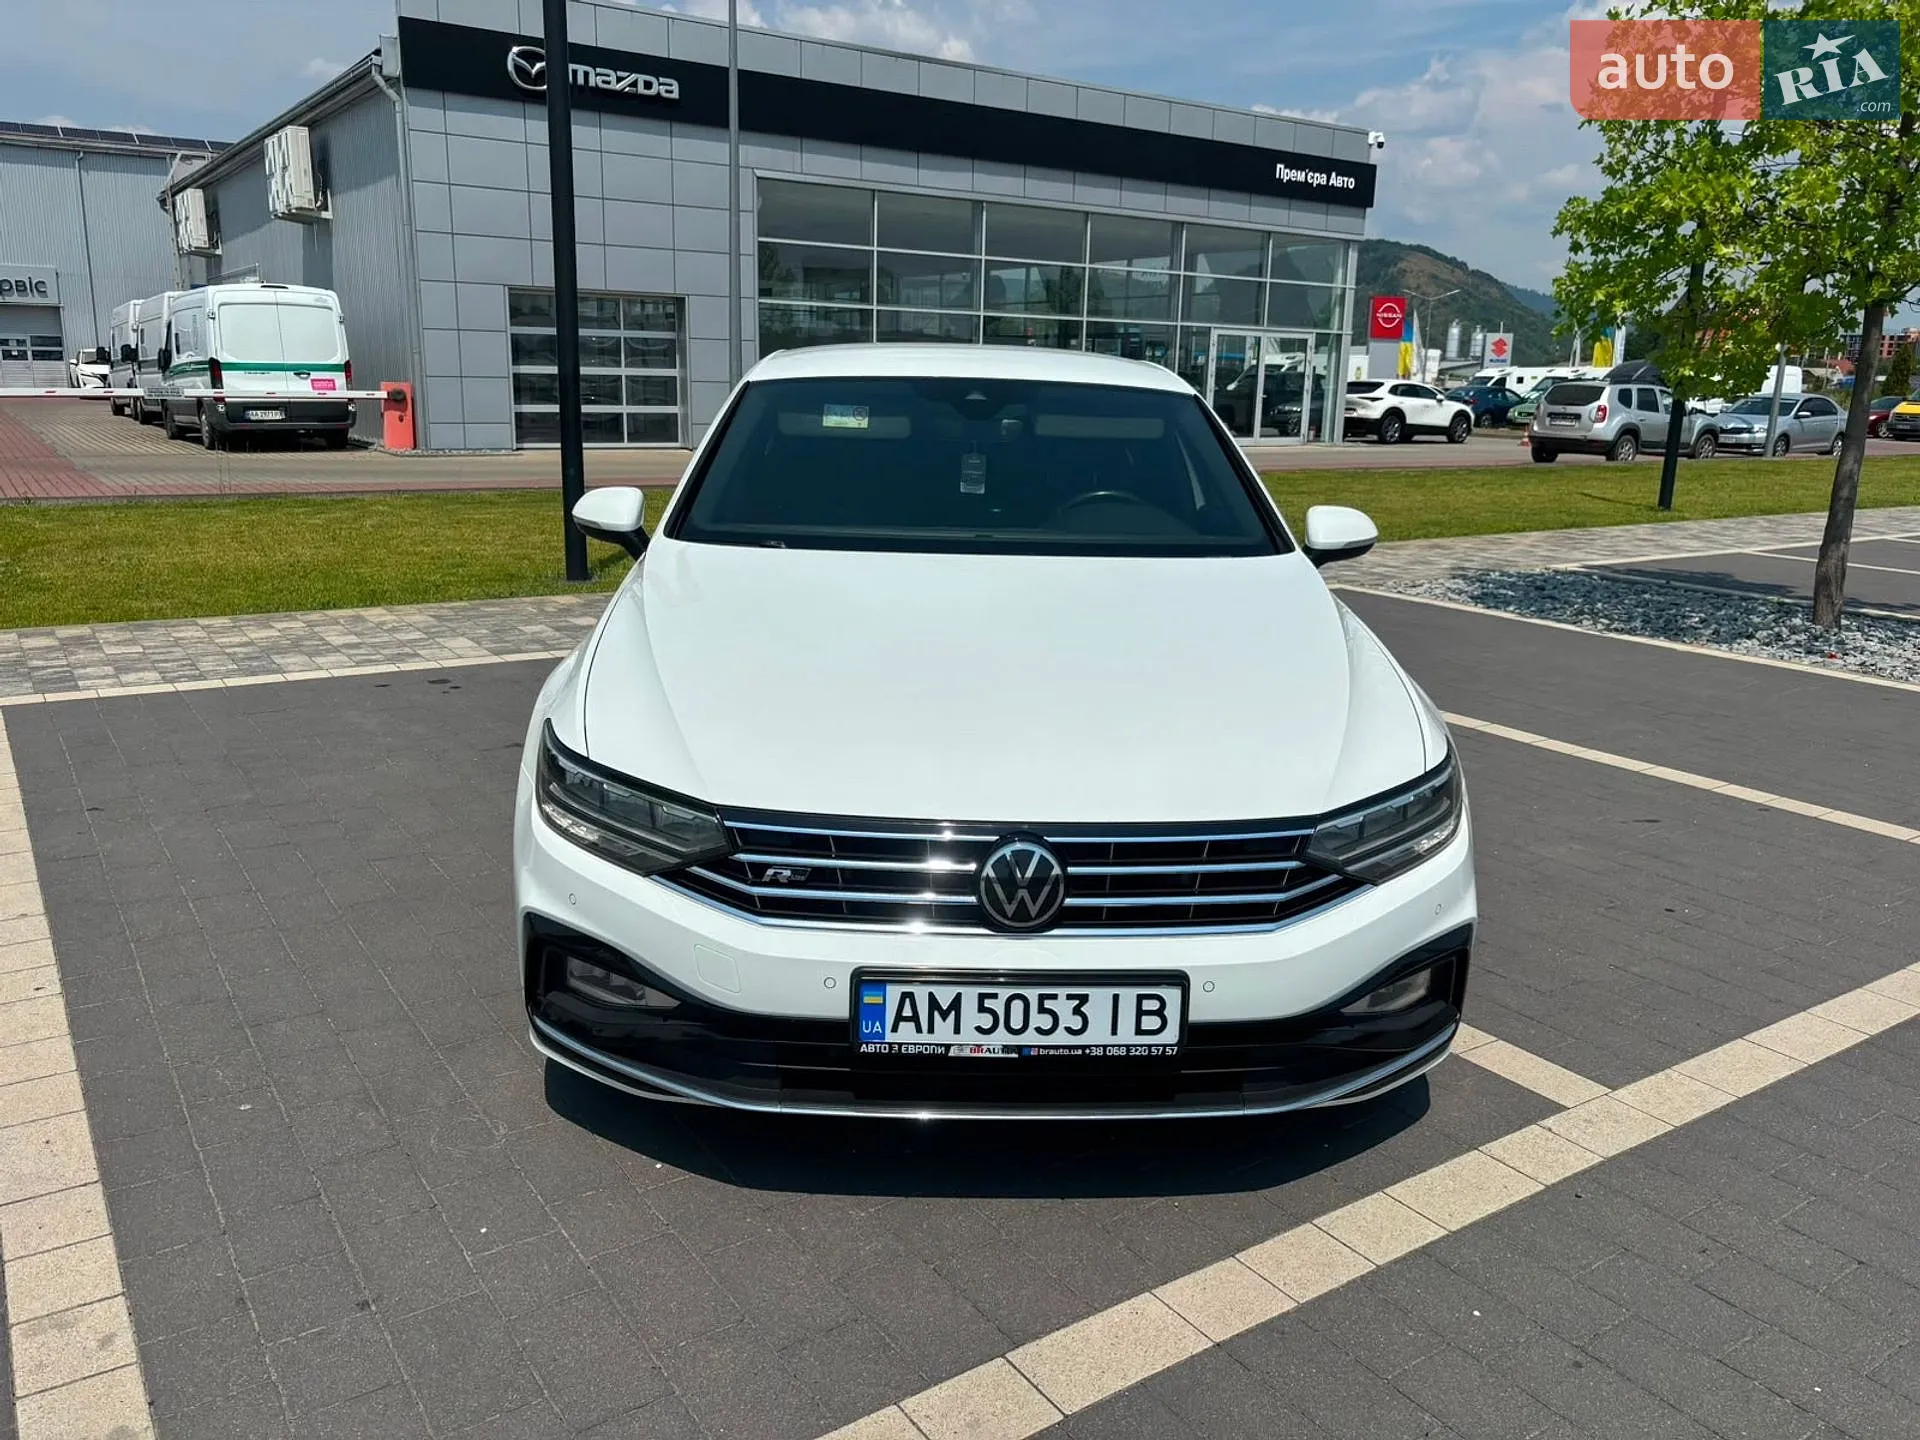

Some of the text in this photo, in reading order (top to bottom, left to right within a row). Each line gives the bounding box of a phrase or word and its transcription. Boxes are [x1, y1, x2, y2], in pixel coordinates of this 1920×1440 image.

[1328, 171, 1355, 189] Авто
[890, 991, 1168, 1037] AM 5053 IB
[862, 1021, 882, 1034] UA
[860, 1044, 889, 1054] АВТО
[1039, 1046, 1178, 1056] brauto.ua +38 068 320 57 57
